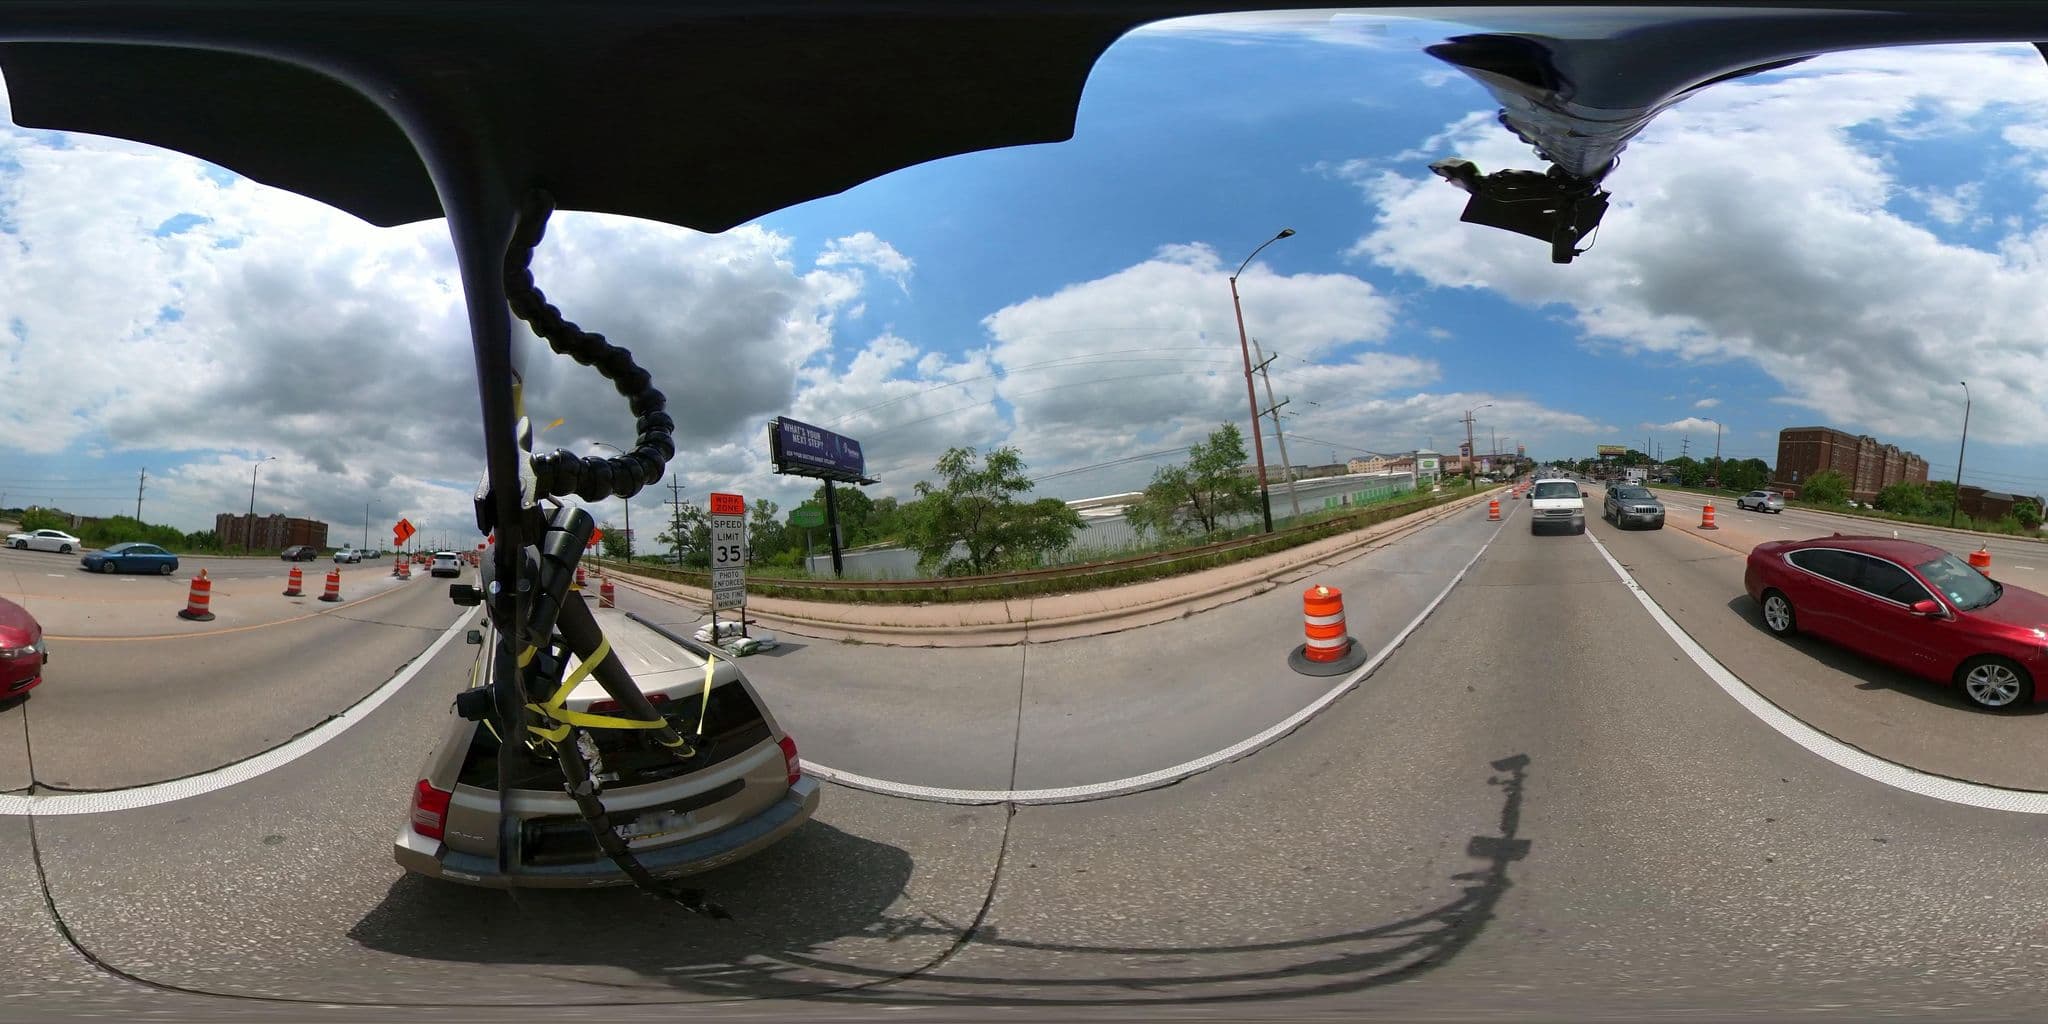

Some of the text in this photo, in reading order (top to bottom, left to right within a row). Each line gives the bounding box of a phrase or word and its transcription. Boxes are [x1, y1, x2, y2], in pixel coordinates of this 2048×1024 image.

[784, 423, 821, 440] WHAT'S YOUR
[792, 433, 824, 450] NEXT STEP?
[716, 495, 739, 504] WORK
[716, 503, 739, 512] ZONE
[713, 520, 742, 529] SPEED
[717, 532, 739, 542] LIMIT
[717, 545, 741, 563] 35
[719, 570, 739, 579] PHOTO
[714, 578, 744, 588] ENFORCED
[731, 591, 744, 599] FINE
[718, 599, 742, 608] MINIMUM
